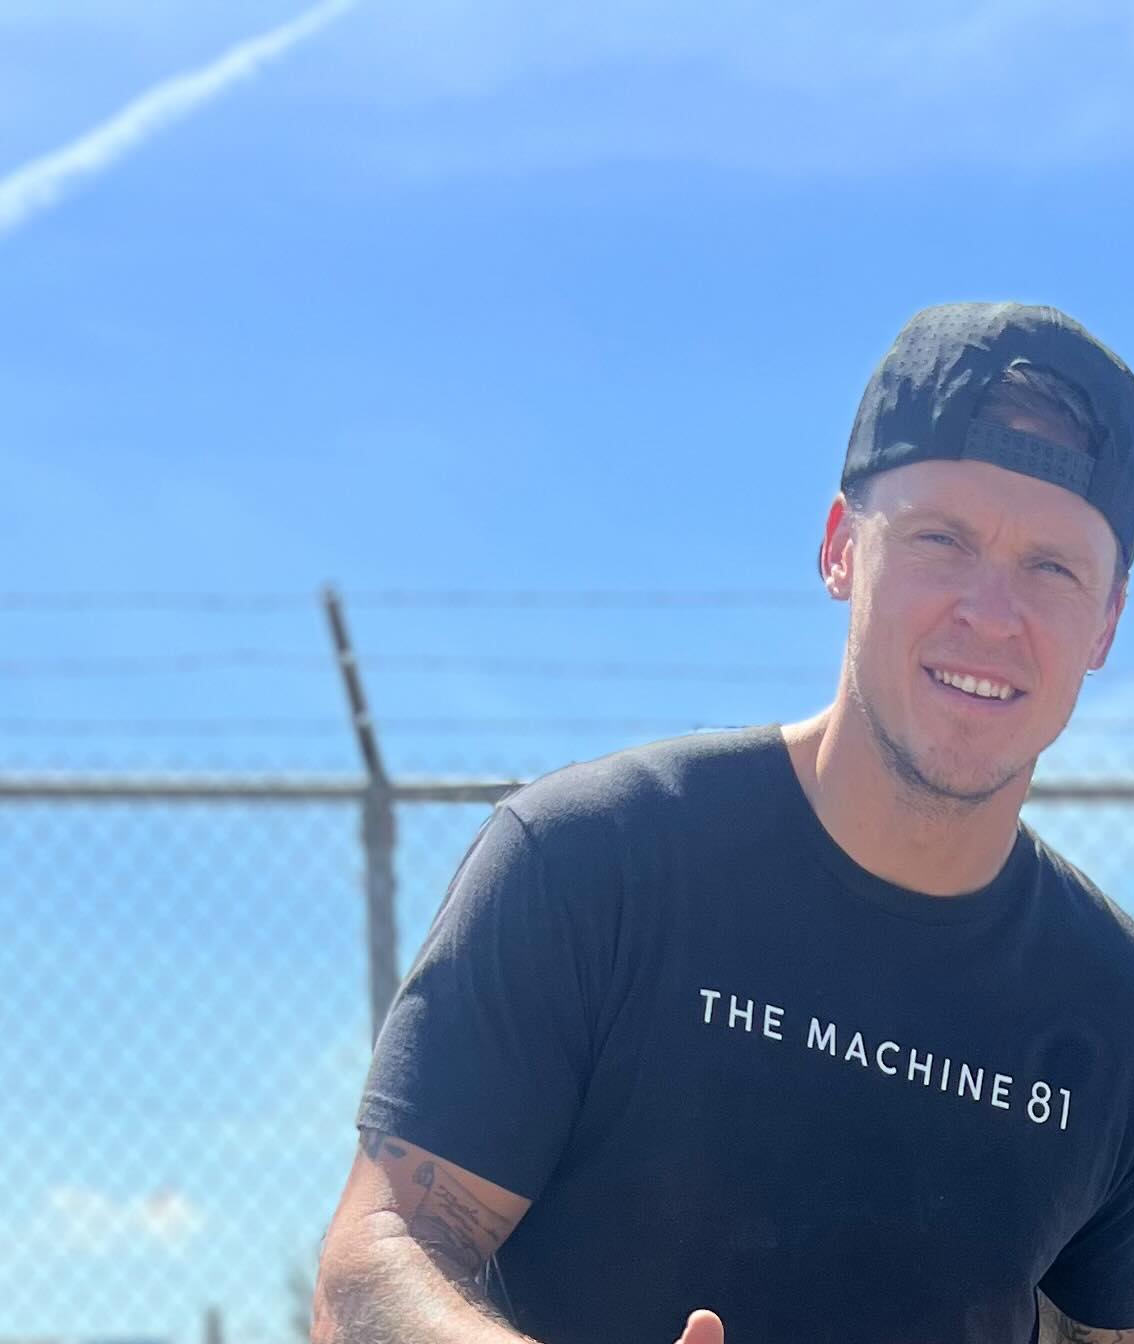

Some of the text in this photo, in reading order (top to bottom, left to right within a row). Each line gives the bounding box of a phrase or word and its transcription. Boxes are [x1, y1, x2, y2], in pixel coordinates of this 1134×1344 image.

[700, 989, 1072, 1130] THE MACHINE 81
